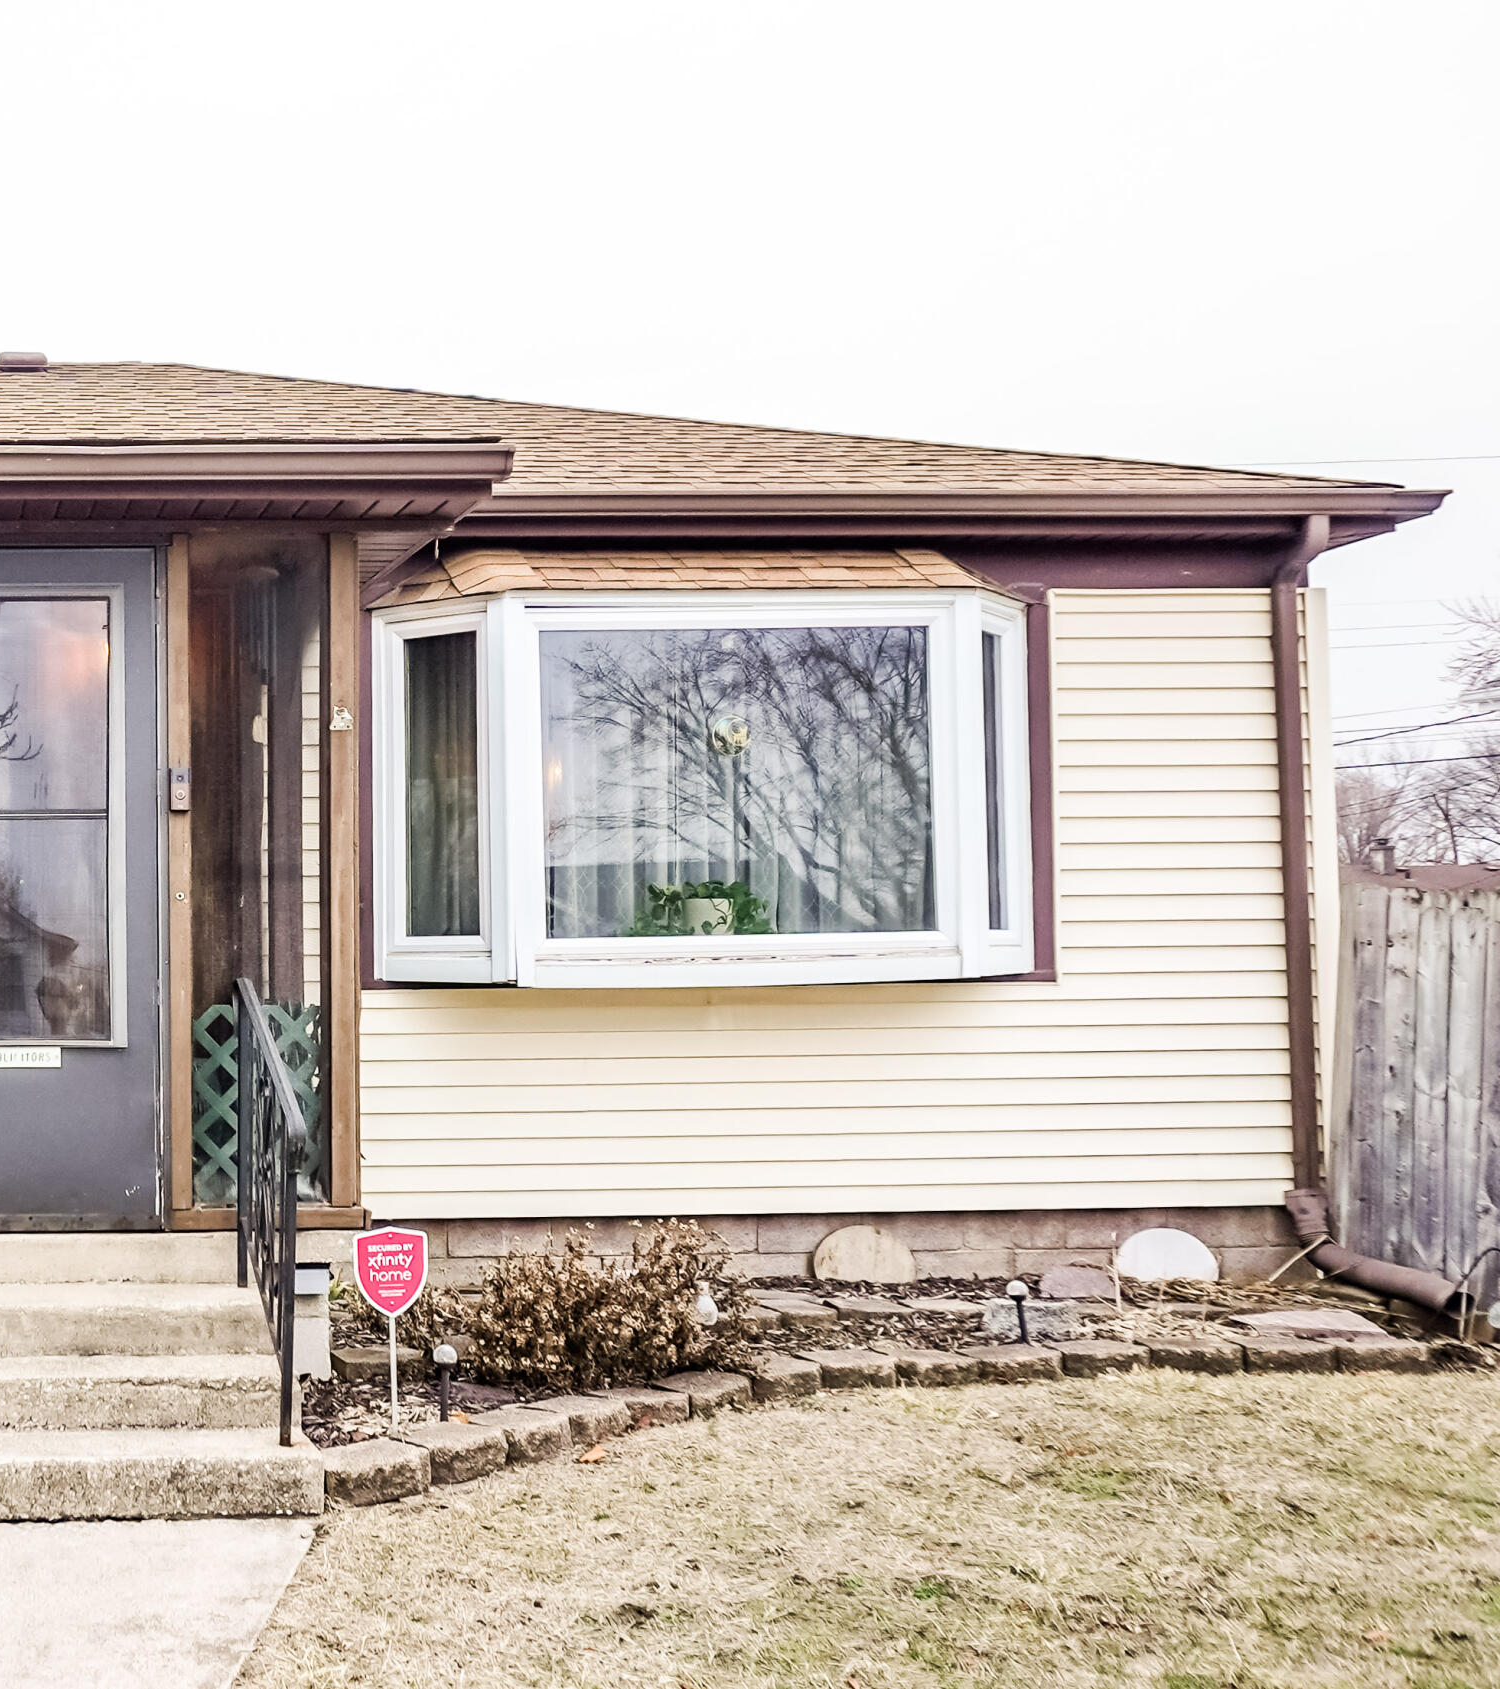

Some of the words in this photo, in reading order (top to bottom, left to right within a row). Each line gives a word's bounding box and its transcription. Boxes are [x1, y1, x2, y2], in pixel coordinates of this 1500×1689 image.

[367, 1244, 402, 1252] SECURED
[402, 1243, 414, 1251] BY
[367, 1252, 414, 1270] xfinity
[369, 1268, 412, 1282] home
